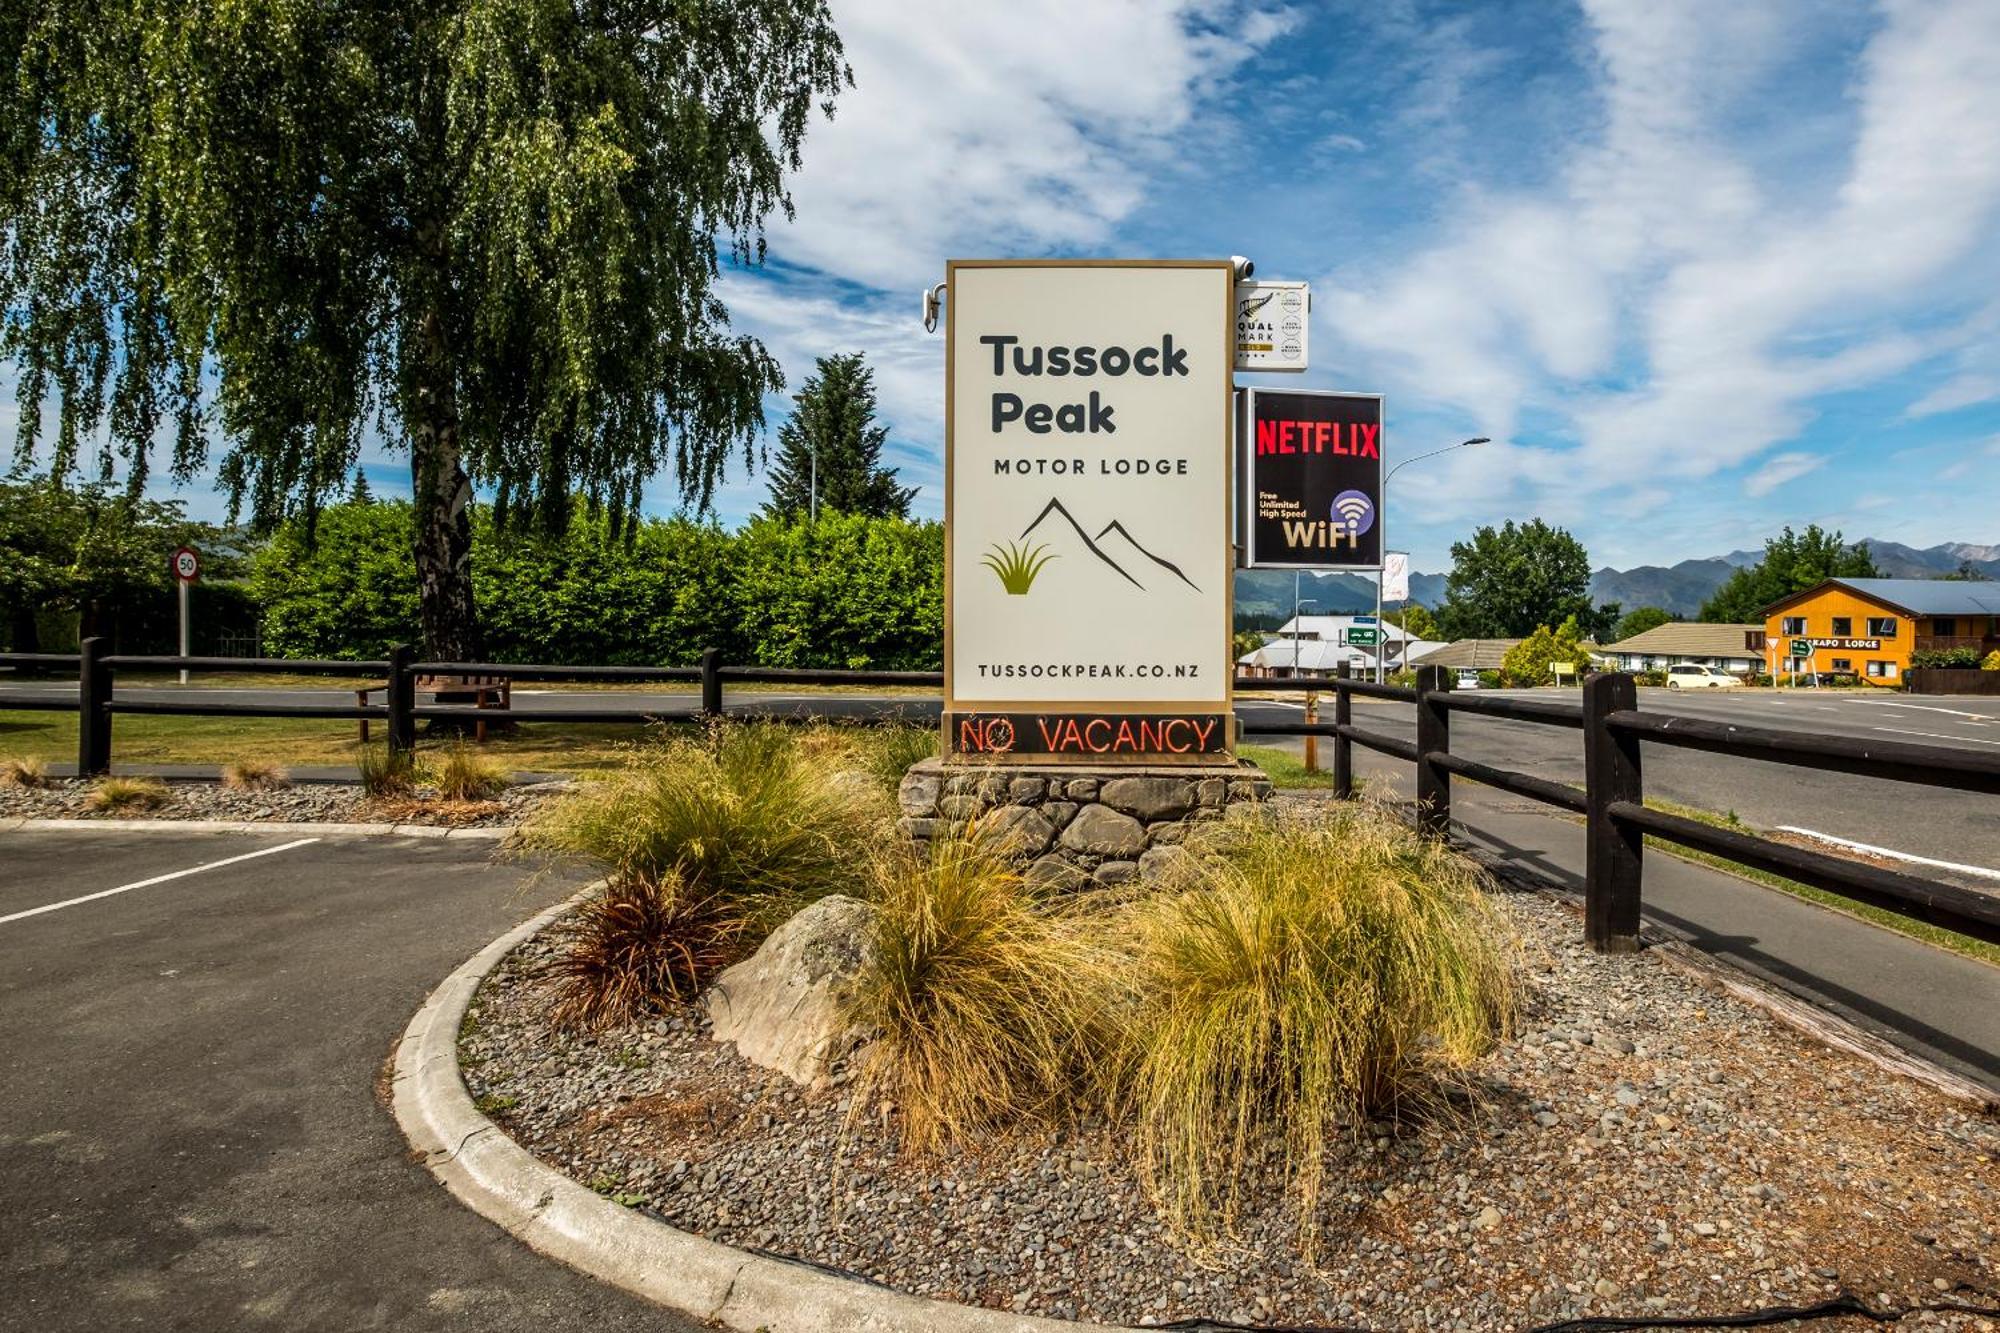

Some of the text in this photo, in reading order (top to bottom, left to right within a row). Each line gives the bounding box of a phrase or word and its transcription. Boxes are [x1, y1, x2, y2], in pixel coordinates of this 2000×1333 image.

[1238, 322, 1273, 331] QUAL
[1238, 333, 1273, 341] MARK
[980, 334, 1189, 377] Tussock
[992, 391, 1117, 434] Peak
[1257, 419, 1379, 460] NETFLIX
[994, 459, 1188, 475] MOTOR LODGE
[1259, 491, 1278, 500] Free
[1259, 500, 1300, 509] Unlimited
[1259, 509, 1307, 519] High Speed
[1282, 520, 1358, 549] WiFi
[180, 559, 194, 570] 50
[1844, 640, 1878, 649] LODGE
[978, 664, 1200, 678] TUSSOCKPEAK.CO.NZ
[961, 719, 1215, 753] NO VACANCY
